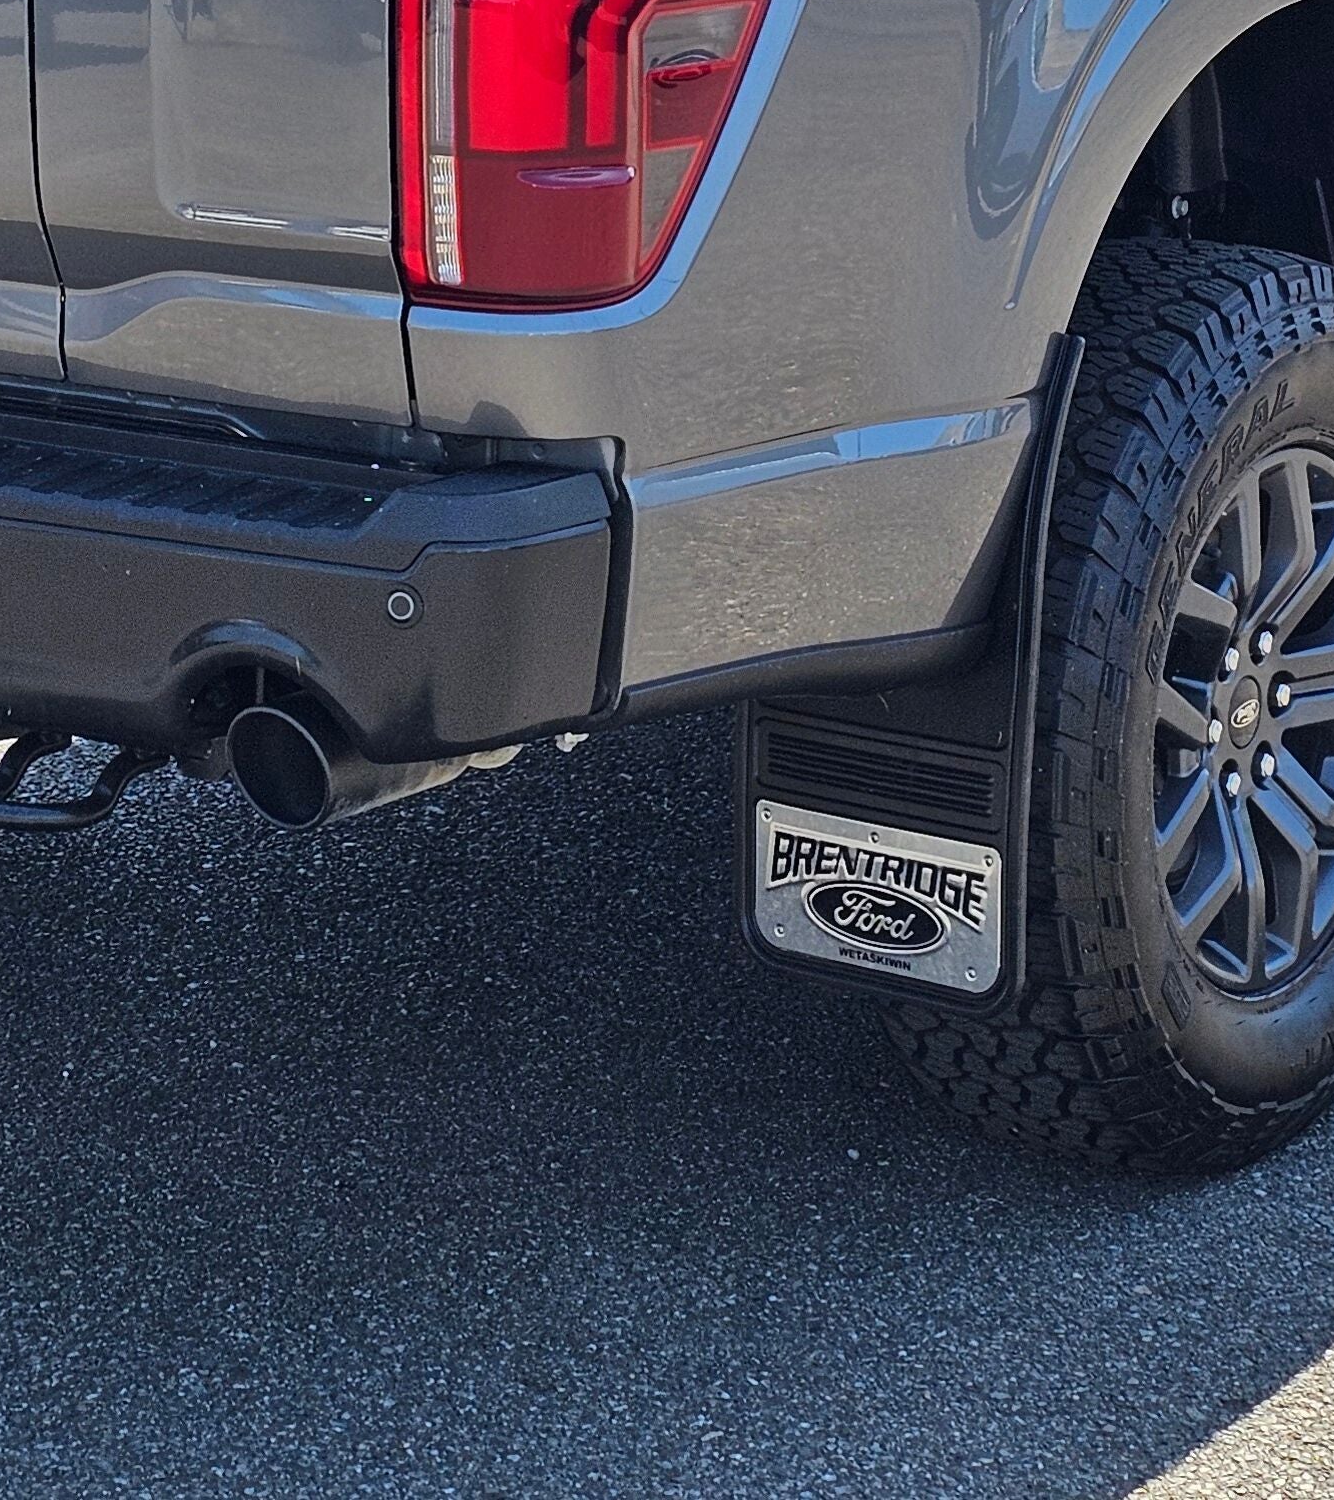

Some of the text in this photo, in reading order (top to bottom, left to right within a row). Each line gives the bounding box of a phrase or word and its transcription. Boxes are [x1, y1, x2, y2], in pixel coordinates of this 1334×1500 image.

[770, 831, 987, 927] BRENTRIDGE
[833, 889, 917, 941] Ford
[838, 946, 912, 972] WETASKIWIN
